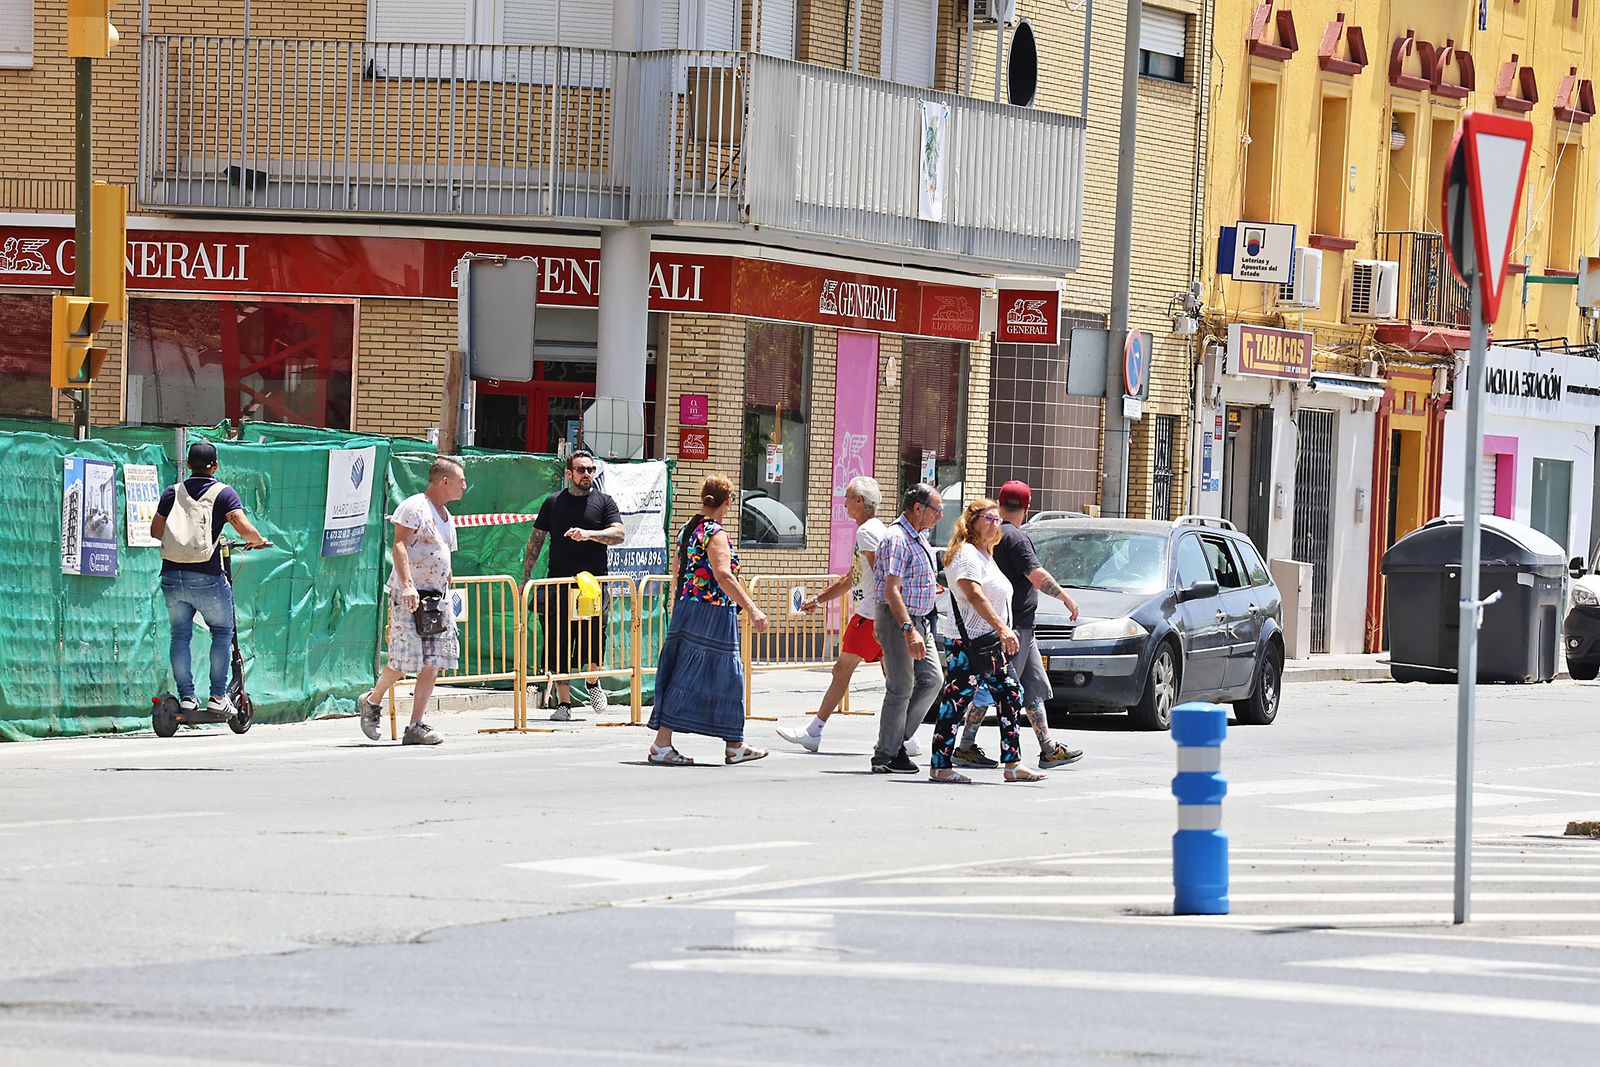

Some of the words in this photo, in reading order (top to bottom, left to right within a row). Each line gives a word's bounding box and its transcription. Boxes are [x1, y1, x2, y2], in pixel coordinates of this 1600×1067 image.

[1241, 257, 1265, 265] Loterías
[1241, 263, 1267, 271] Apuestas
[838, 281, 898, 322] GENERALI
[1006, 325, 1048, 335] GENERALI
[1255, 333, 1305, 364] TABACOS
[1508, 370, 1520, 396] LA
[624, 551, 635, 566] 615
[648, 551, 662, 566] 896
